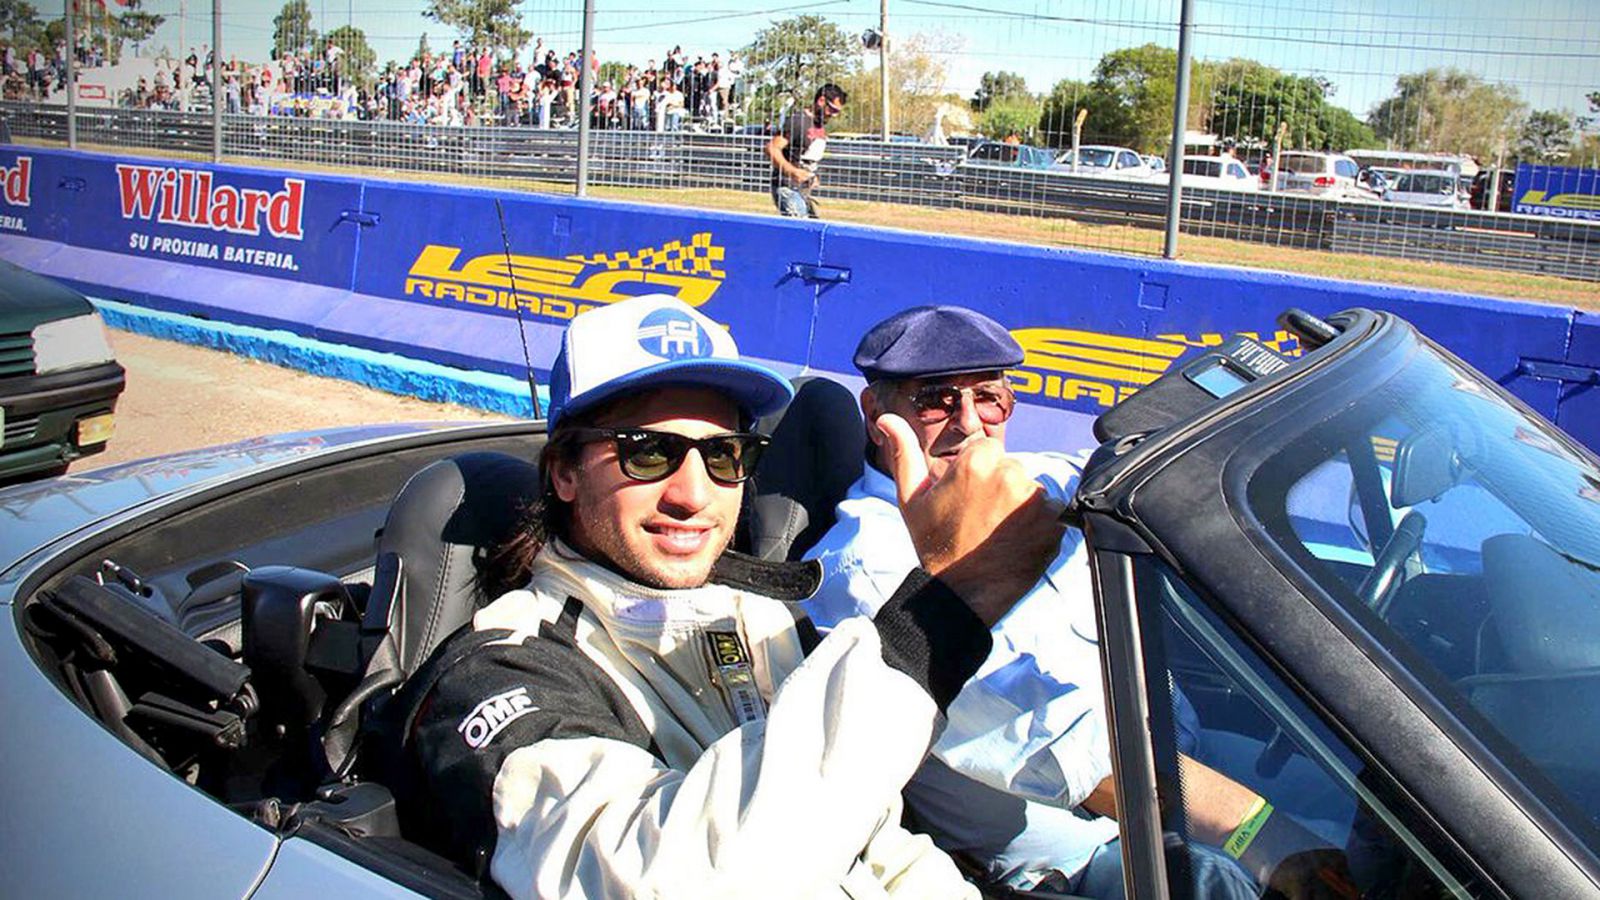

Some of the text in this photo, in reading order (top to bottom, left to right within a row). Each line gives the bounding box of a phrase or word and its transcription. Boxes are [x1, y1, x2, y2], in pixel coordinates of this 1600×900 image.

[116, 164, 305, 240] Willard
[129, 233, 299, 271] SU PROXIMA BATERIA.
[408, 244, 723, 308] LEO
[464, 694, 533, 748] OMP
